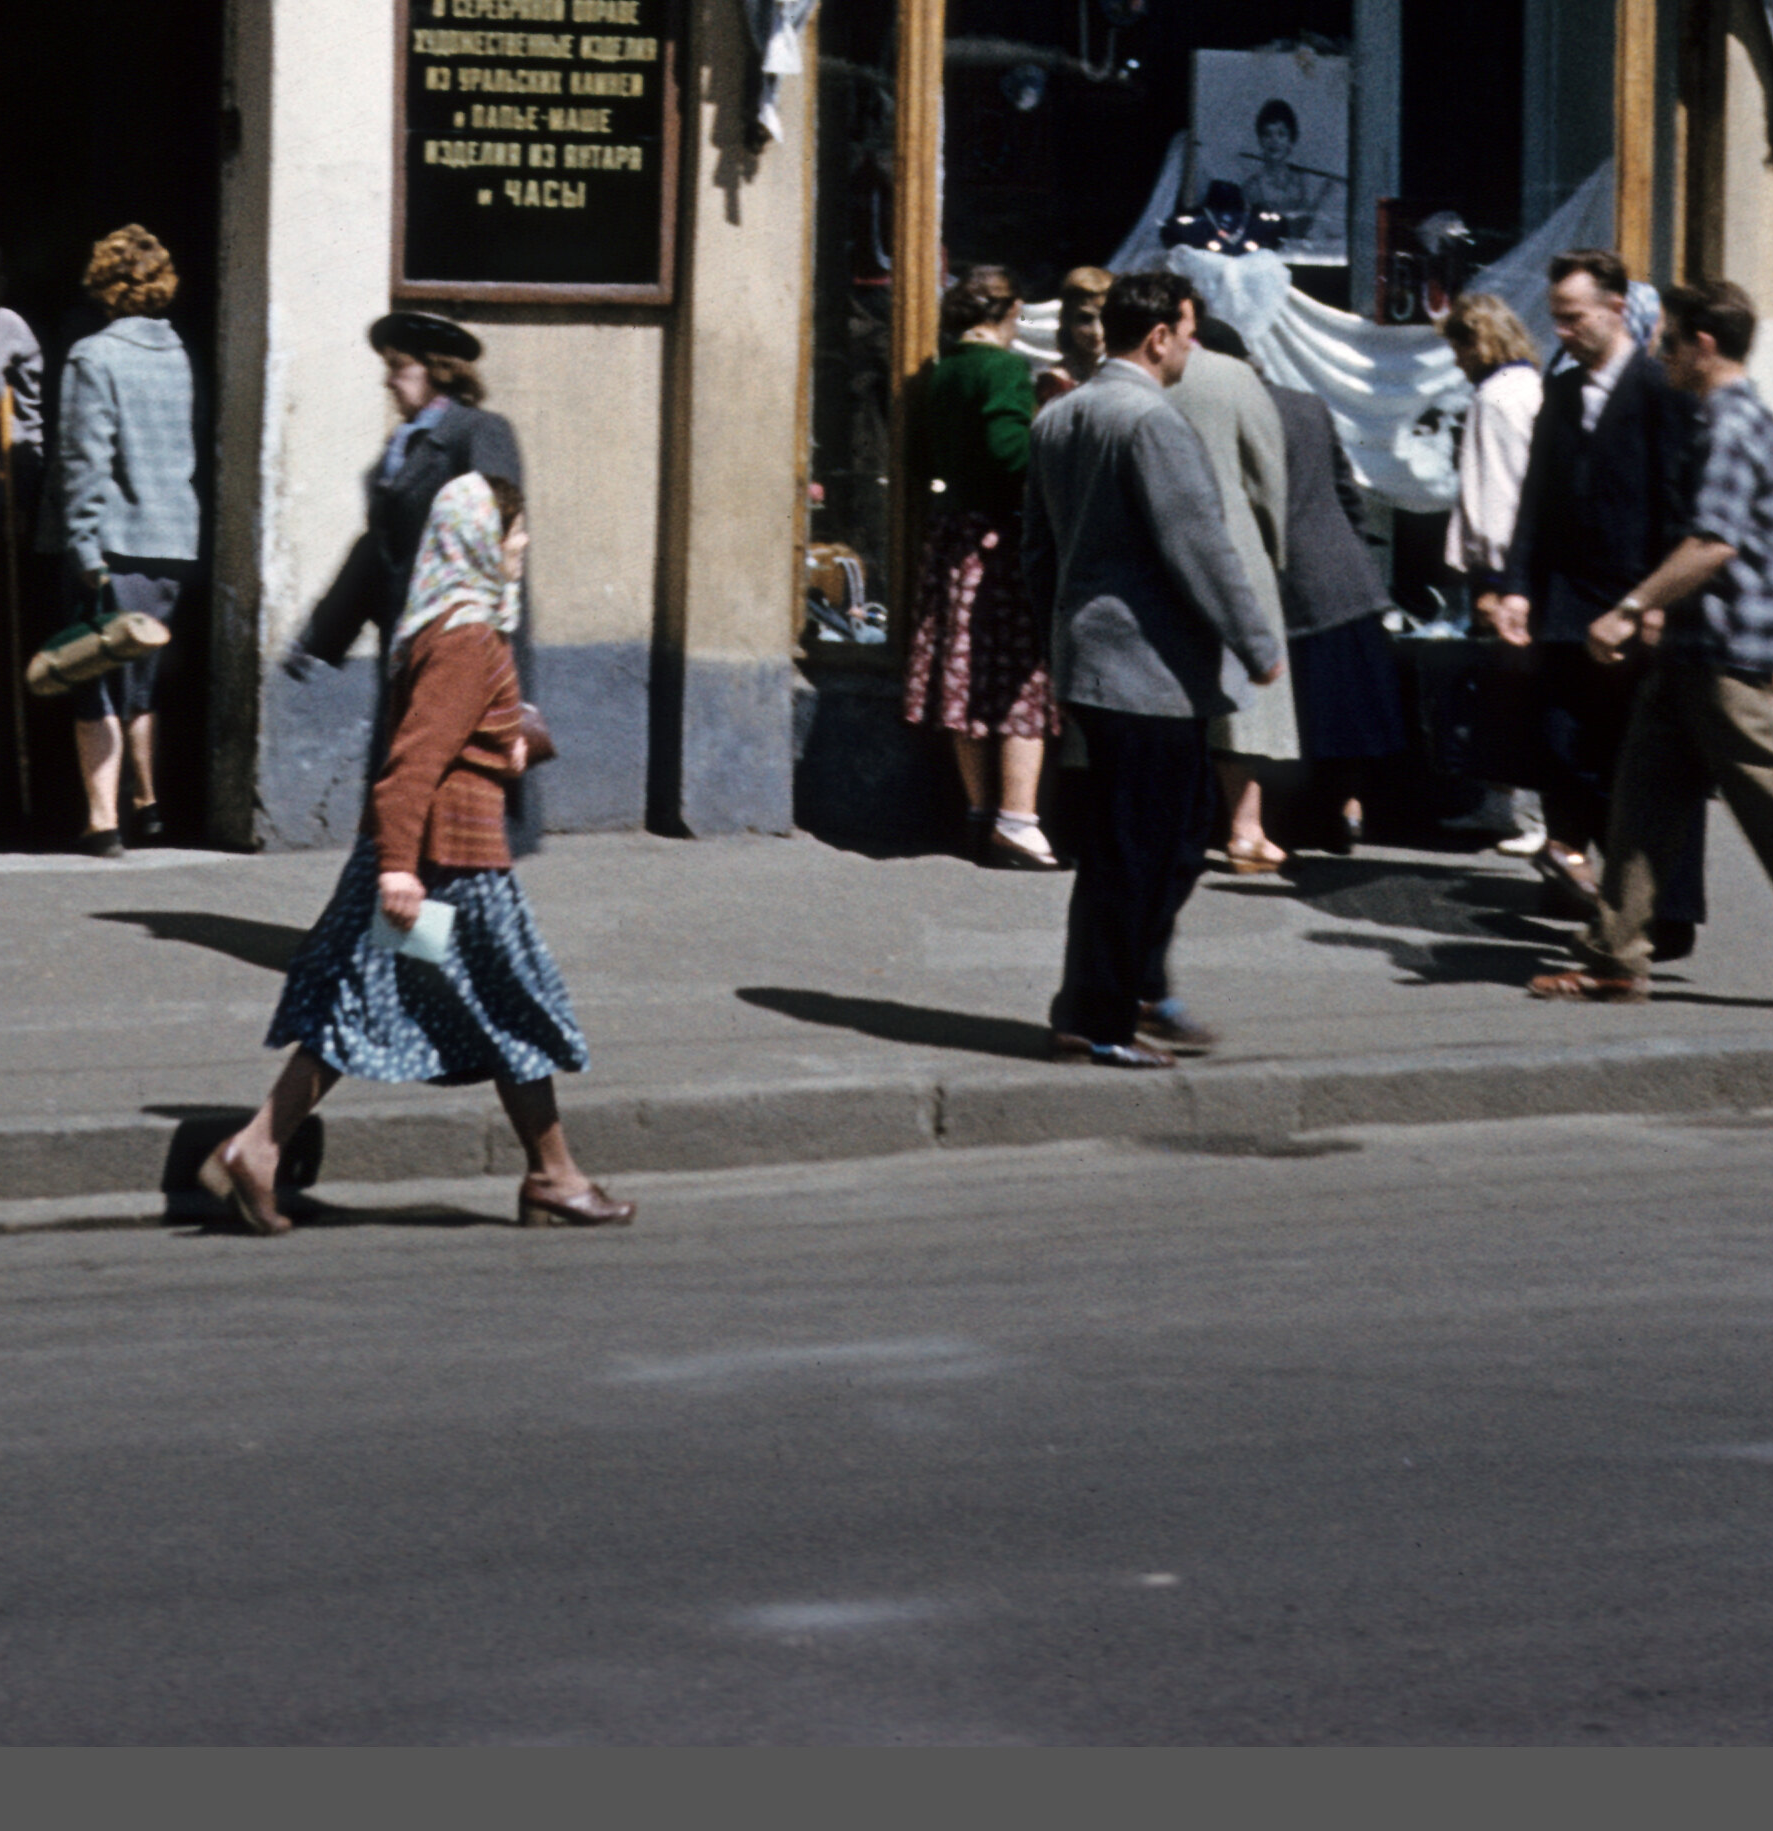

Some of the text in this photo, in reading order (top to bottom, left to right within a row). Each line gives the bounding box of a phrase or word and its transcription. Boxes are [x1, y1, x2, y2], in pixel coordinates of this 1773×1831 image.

[426, 66, 450, 90] ИЗ
[425, 140, 642, 171] ИЗДЕЛИЯ ИЗ ЯНТАРЯ
[504, 179, 586, 208] ЧАСЫ
